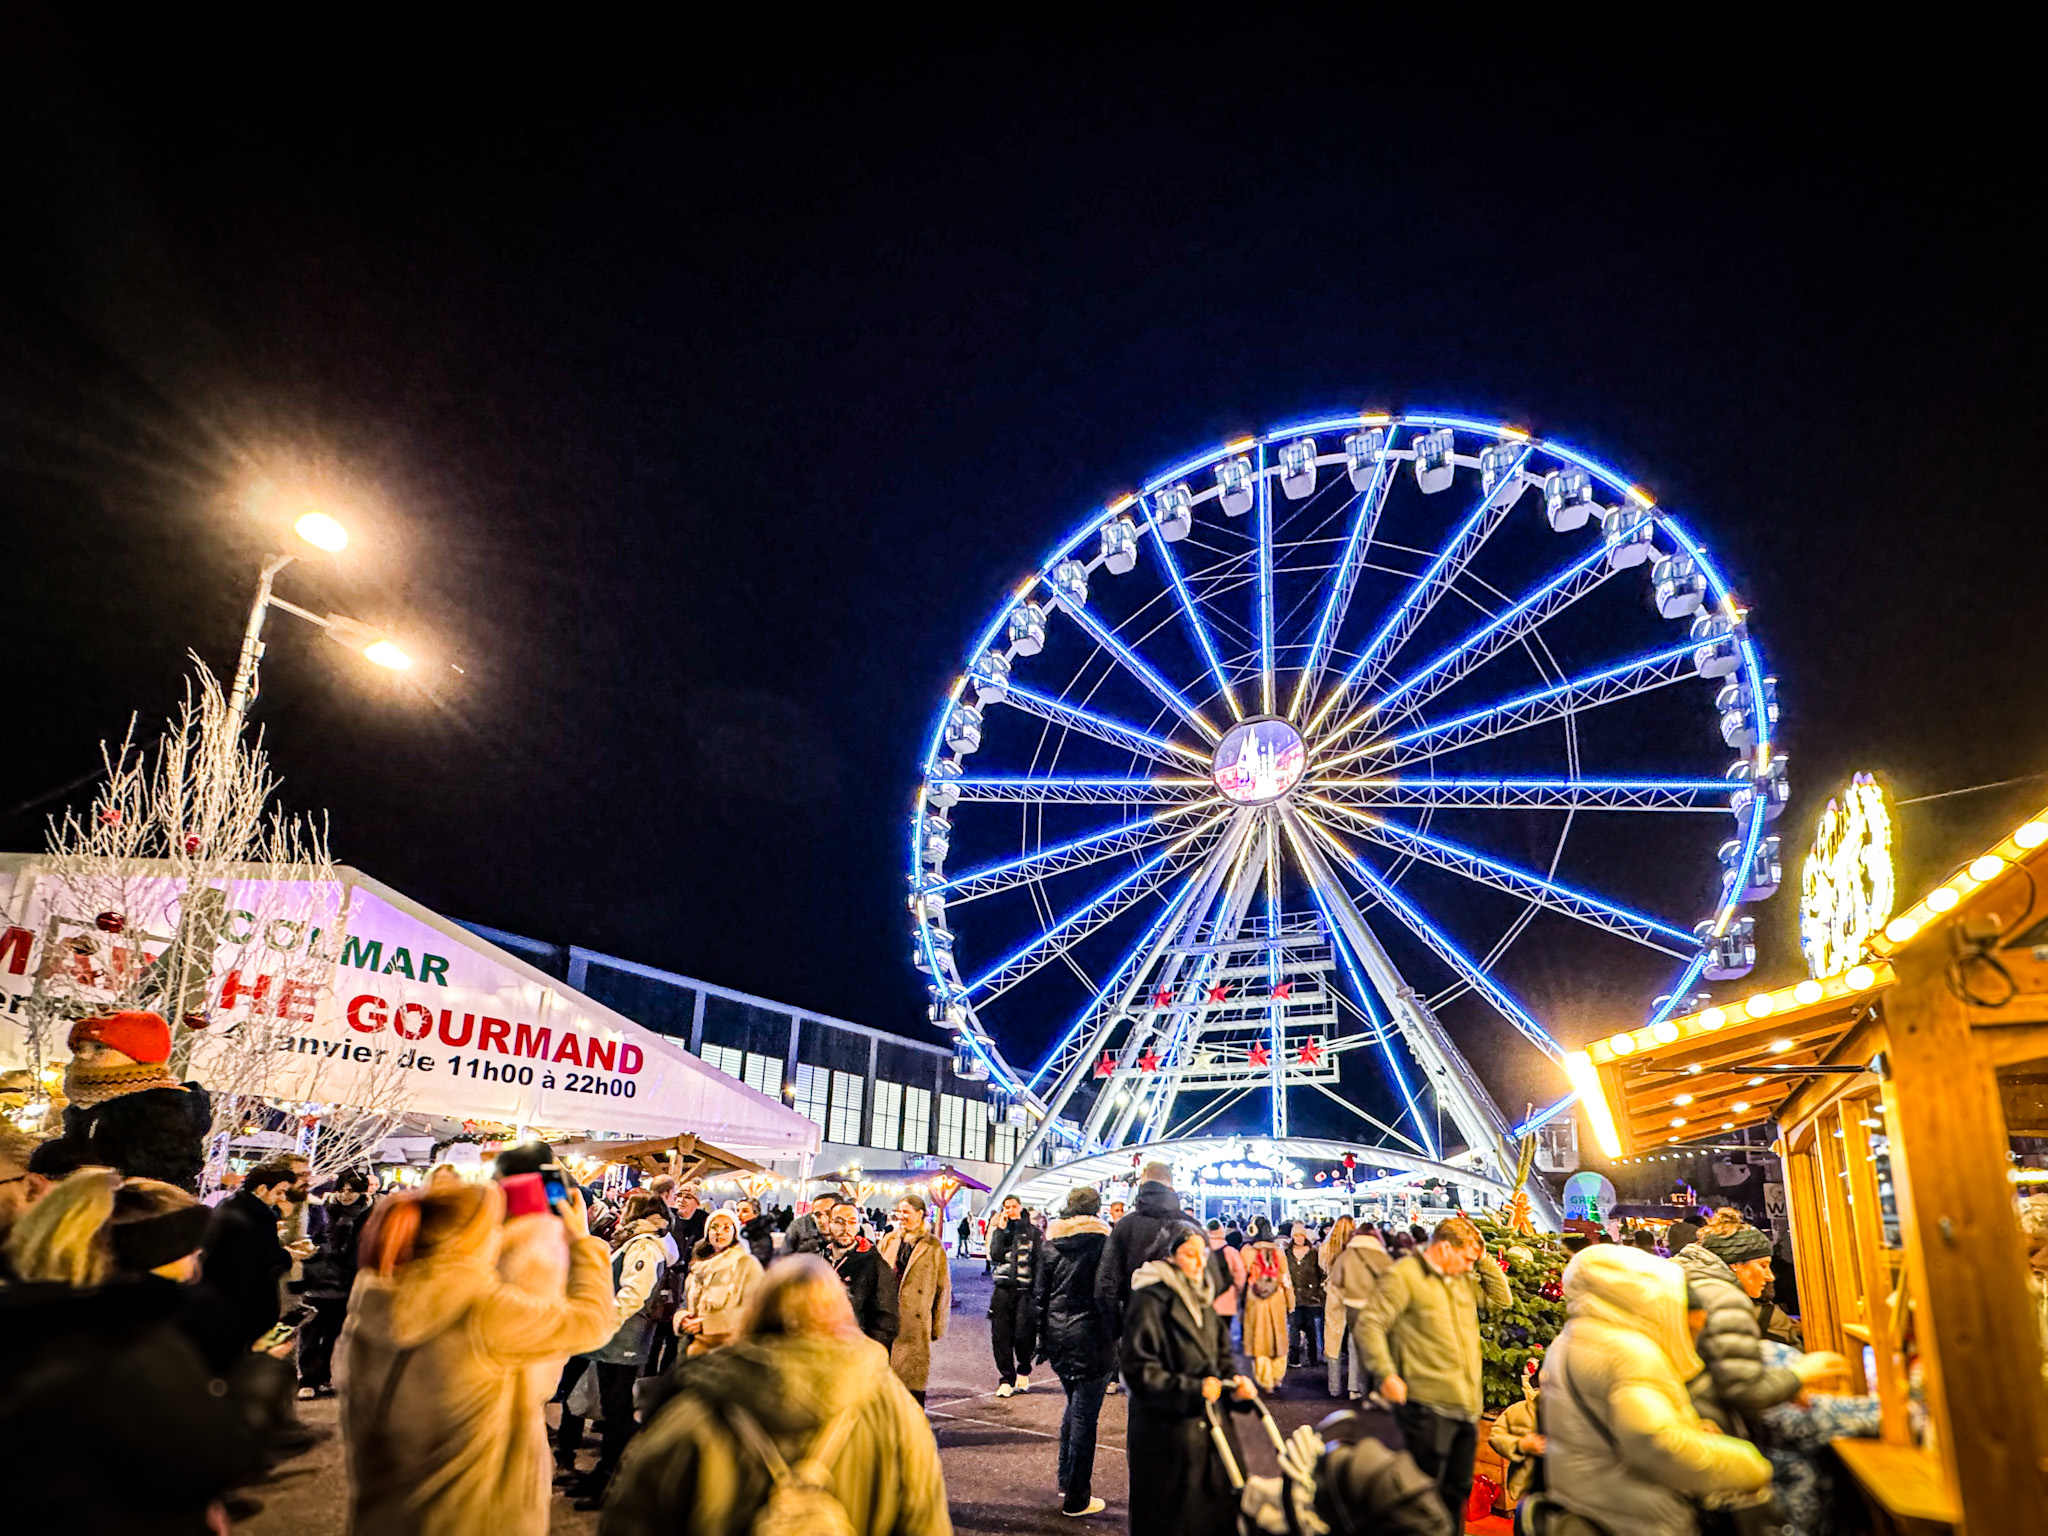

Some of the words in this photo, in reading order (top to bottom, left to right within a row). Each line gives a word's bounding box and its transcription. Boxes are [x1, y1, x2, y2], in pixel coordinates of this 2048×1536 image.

[219, 909, 450, 987] COLMAR
[346, 993, 644, 1075] GOURMAND
[396, 1048, 435, 1073] de
[447, 1055, 534, 1086] 11h00
[541, 1070, 556, 1090] à
[564, 1072, 637, 1098] 22h00
